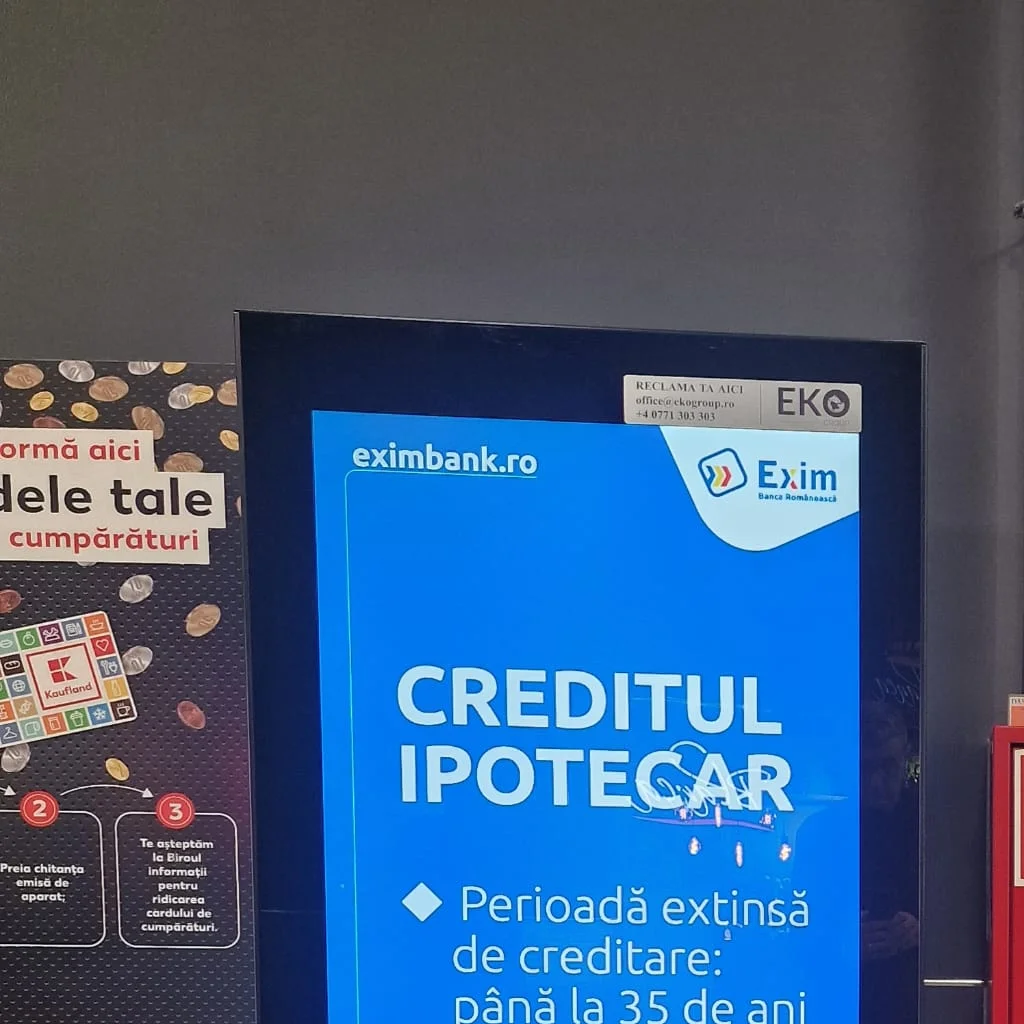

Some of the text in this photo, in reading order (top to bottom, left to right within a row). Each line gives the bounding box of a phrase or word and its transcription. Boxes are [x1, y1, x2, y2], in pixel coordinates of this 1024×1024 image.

[636, 381, 744, 394] RECLAMA TA AICI
[778, 387, 850, 418] EKO
[636, 410, 716, 421] +4 0771 303 303
[89, 438, 140, 461] aici
[352, 442, 538, 476] eximbank.ro
[758, 460, 837, 491] Exim
[110, 477, 213, 516] tale
[758, 492, 782, 500] Banca
[9, 527, 199, 553] cumpărături
[44, 682, 93, 700] Kaufland
[397, 665, 783, 735] CREDITUL
[400, 744, 795, 812] IPOTECAR
[32, 799, 47, 817] 2
[168, 802, 184, 821] 3
[140, 838, 154, 848] Te
[152, 852, 202, 863] la Biroul
[0, 863, 31, 873] Preia
[54, 877, 69, 888] de
[158, 881, 198, 892] pentru
[21, 892, 66, 903] aparat;
[152, 894, 205, 905] ridicarea
[461, 885, 809, 928] Perioadă extinsă
[146, 908, 212, 919] cardului de
[453, 934, 722, 977] de creditare:
